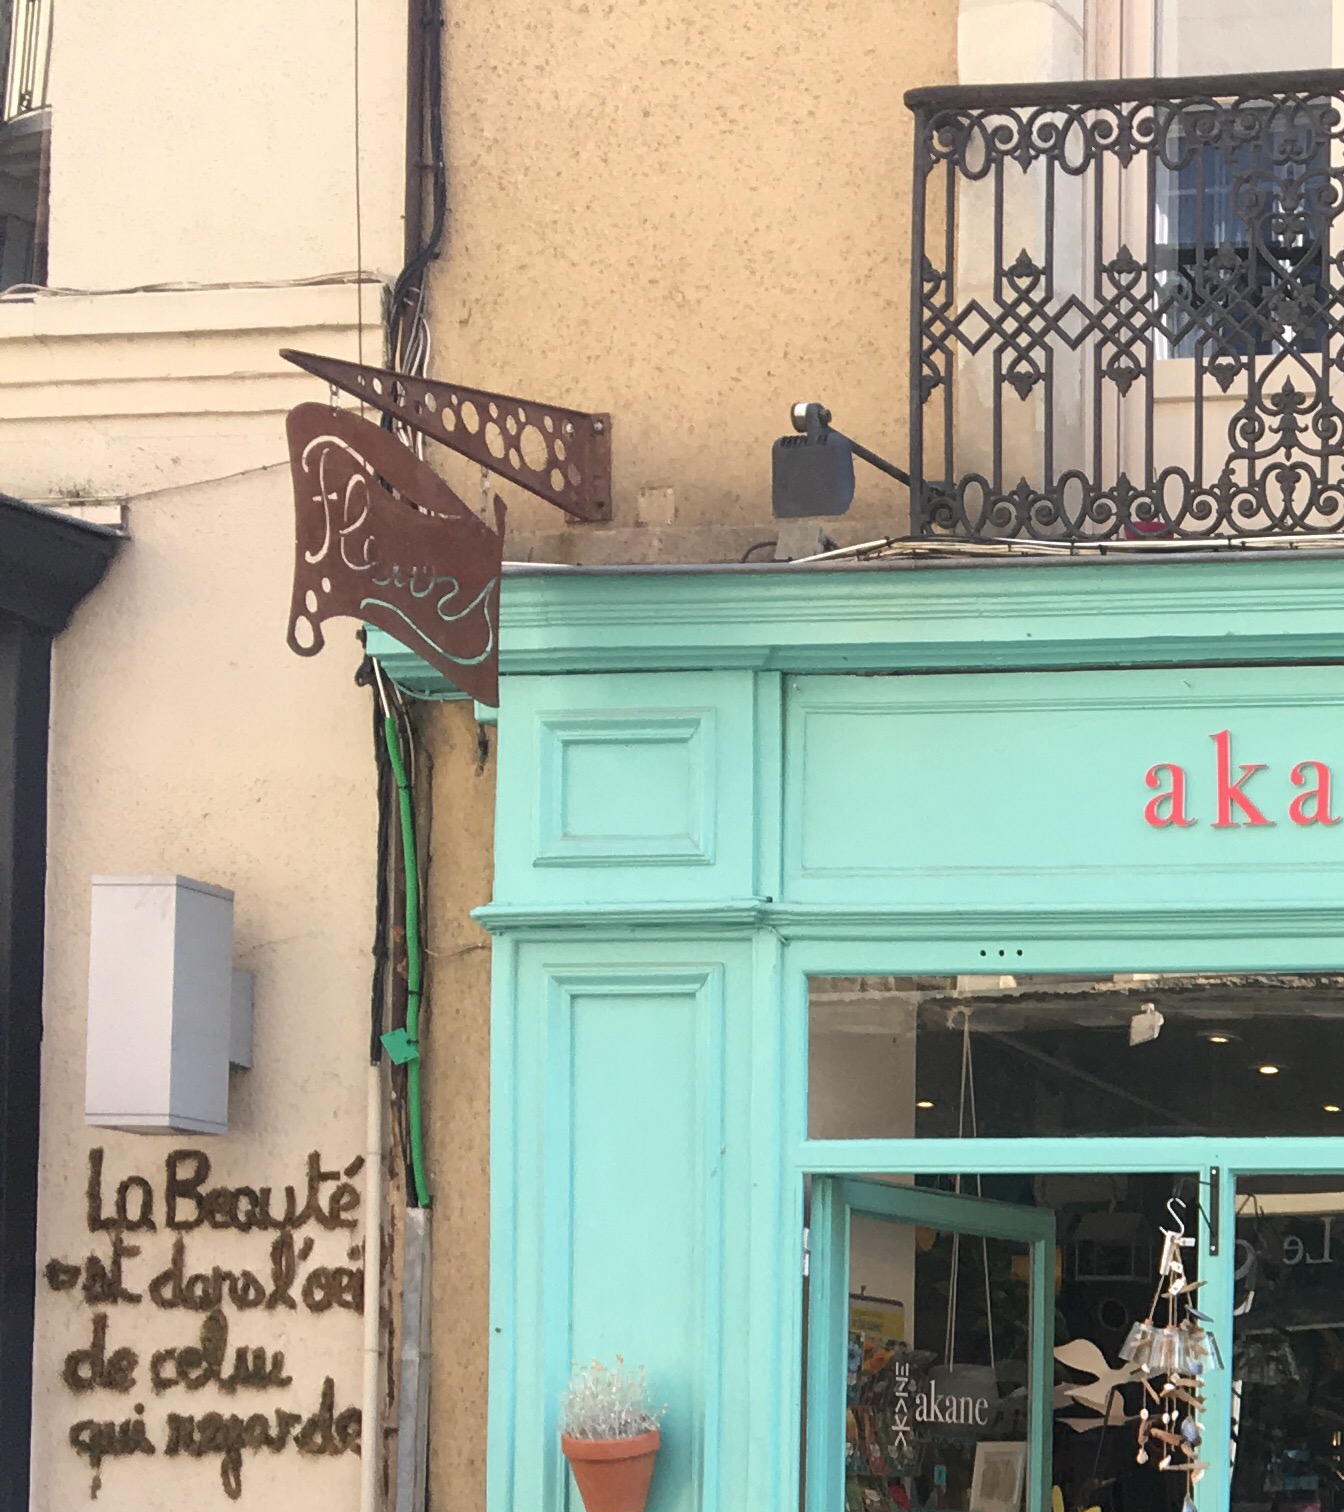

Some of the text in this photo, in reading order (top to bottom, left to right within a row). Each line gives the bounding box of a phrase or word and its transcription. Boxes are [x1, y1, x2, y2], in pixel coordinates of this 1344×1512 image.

[87, 1147, 364, 1232] La Beauté
[149, 1236, 266, 1311] dans
[60, 1311, 139, 1393] de
[915, 1379, 989, 1426] akane
[69, 1402, 156, 1500] qui
